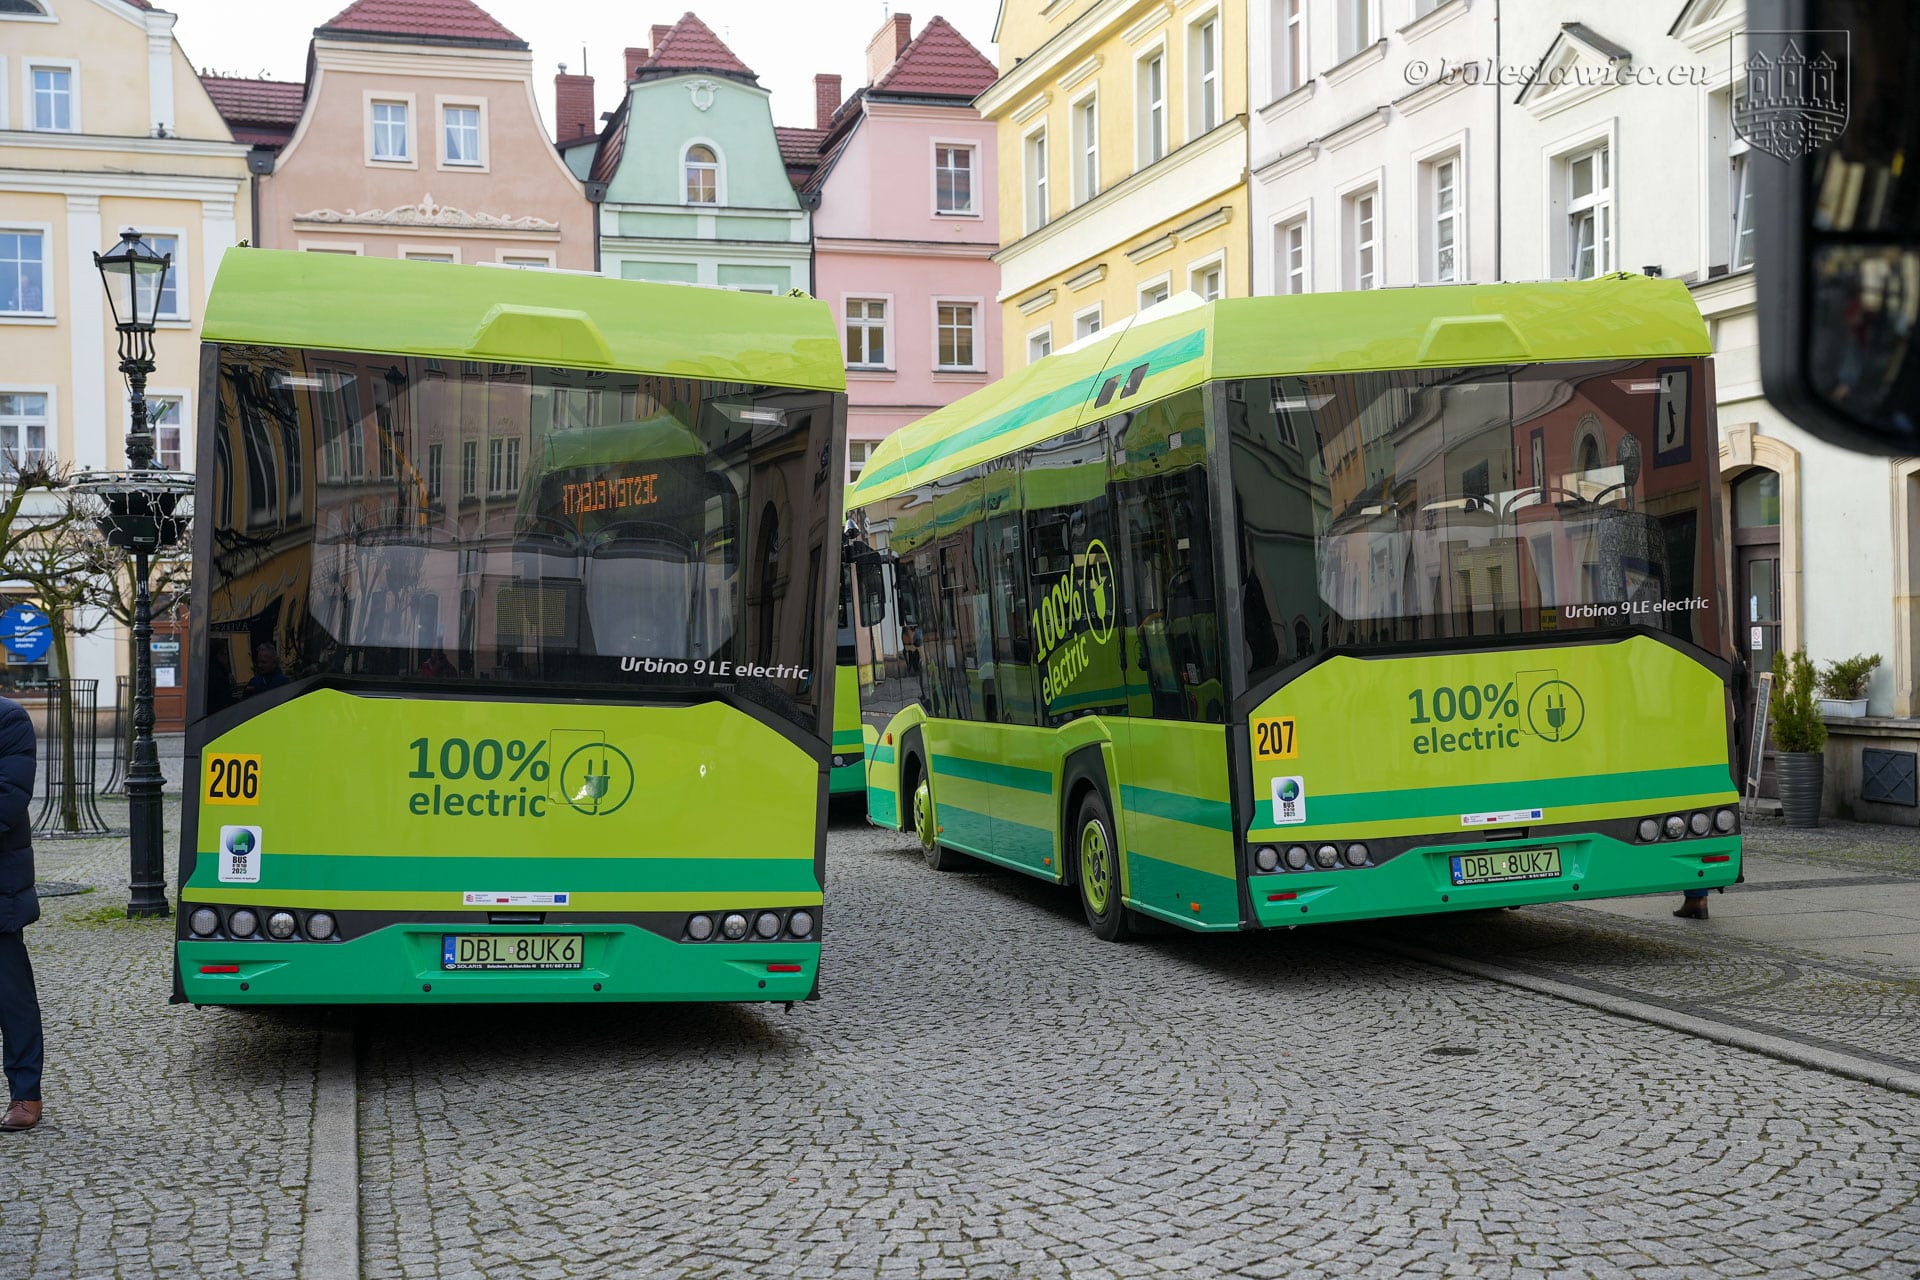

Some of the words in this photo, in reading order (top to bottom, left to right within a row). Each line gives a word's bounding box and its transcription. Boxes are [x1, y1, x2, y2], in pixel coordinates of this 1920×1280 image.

[1032, 563, 1082, 664] 100%
[1565, 604, 1617, 619] Urbino
[1653, 596, 1710, 612] electric
[620, 656, 688, 675] Urbino
[735, 662, 811, 681] electric
[1042, 632, 1090, 706] electric
[1408, 682, 1519, 725] 100%
[1257, 720, 1294, 756] 207
[1413, 723, 1521, 755] electric
[408, 737, 550, 782] 100%
[209, 758, 259, 799] 206
[409, 784, 547, 817] electric
[231, 867, 248, 875] 2025
[232, 856, 248, 864] BUS
[1464, 855, 1502, 878] DBL
[1507, 851, 1553, 874] 8UK7
[445, 953, 455, 961] PL
[460, 939, 506, 962] DBL
[516, 938, 576, 961] 8UK6
